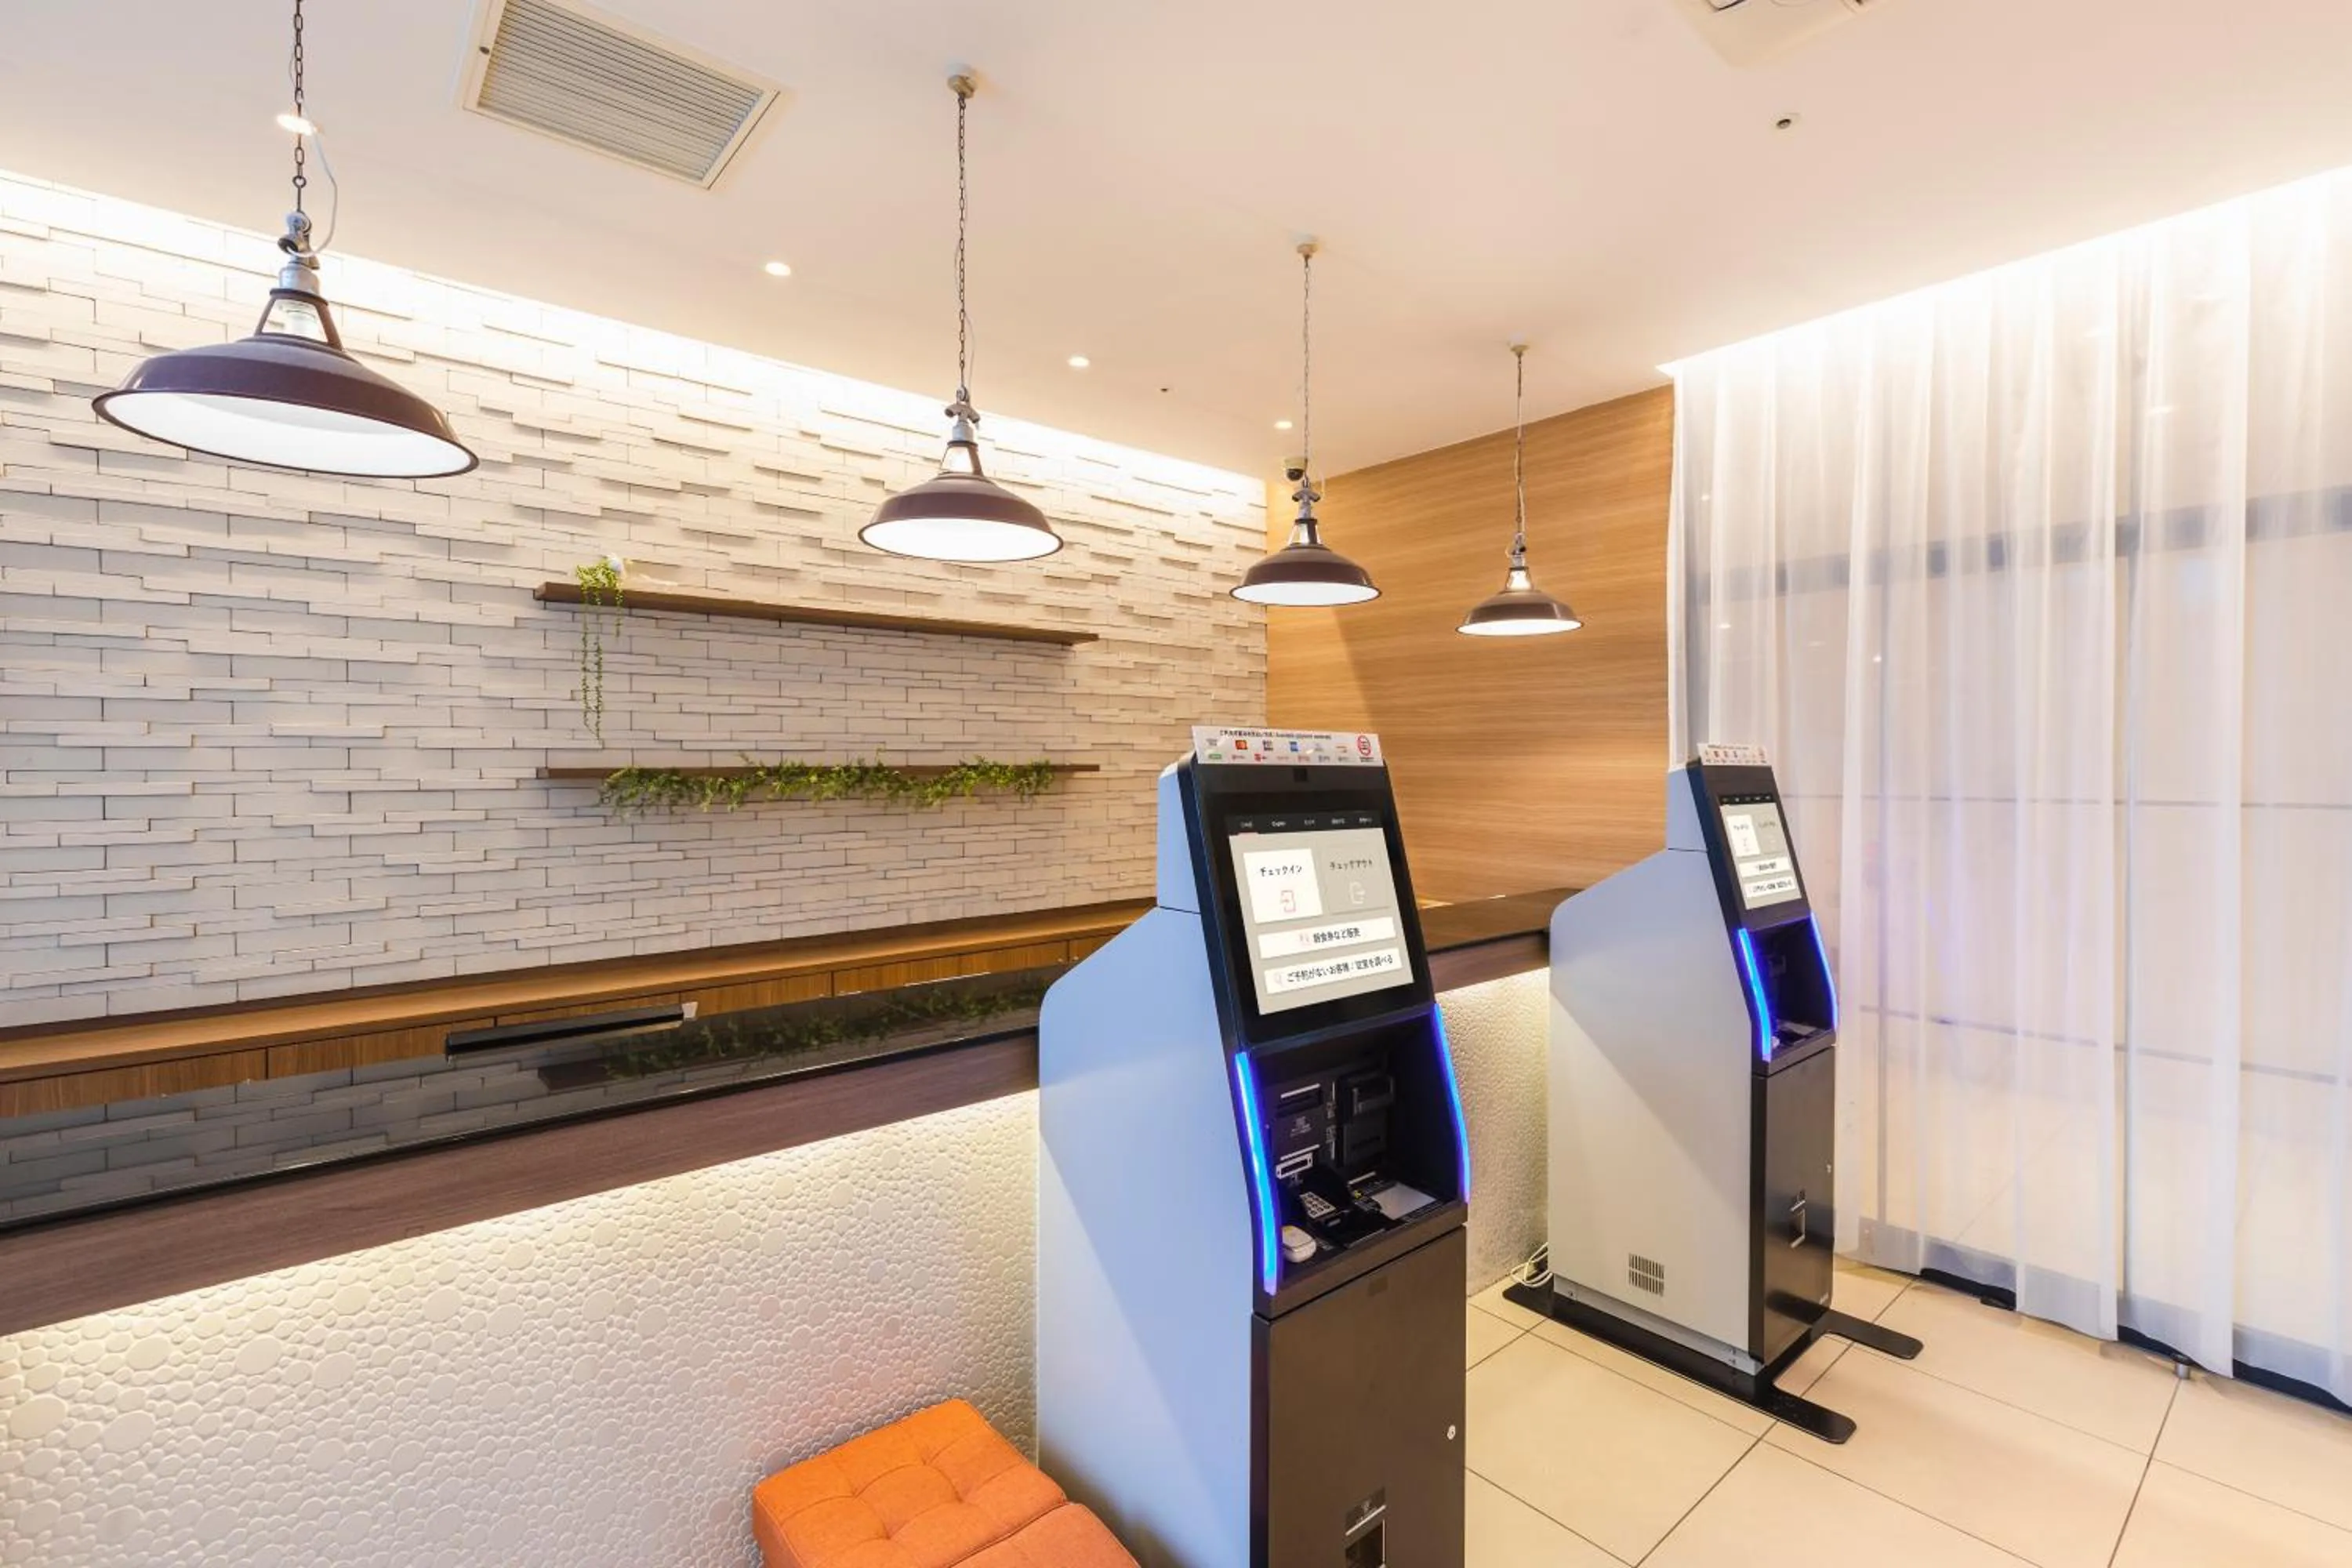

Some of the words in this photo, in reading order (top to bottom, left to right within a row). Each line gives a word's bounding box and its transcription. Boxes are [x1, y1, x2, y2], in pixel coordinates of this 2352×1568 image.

[1260, 865, 1302, 877] チェックイン
[1329, 859, 1374, 871] チェックアウト
